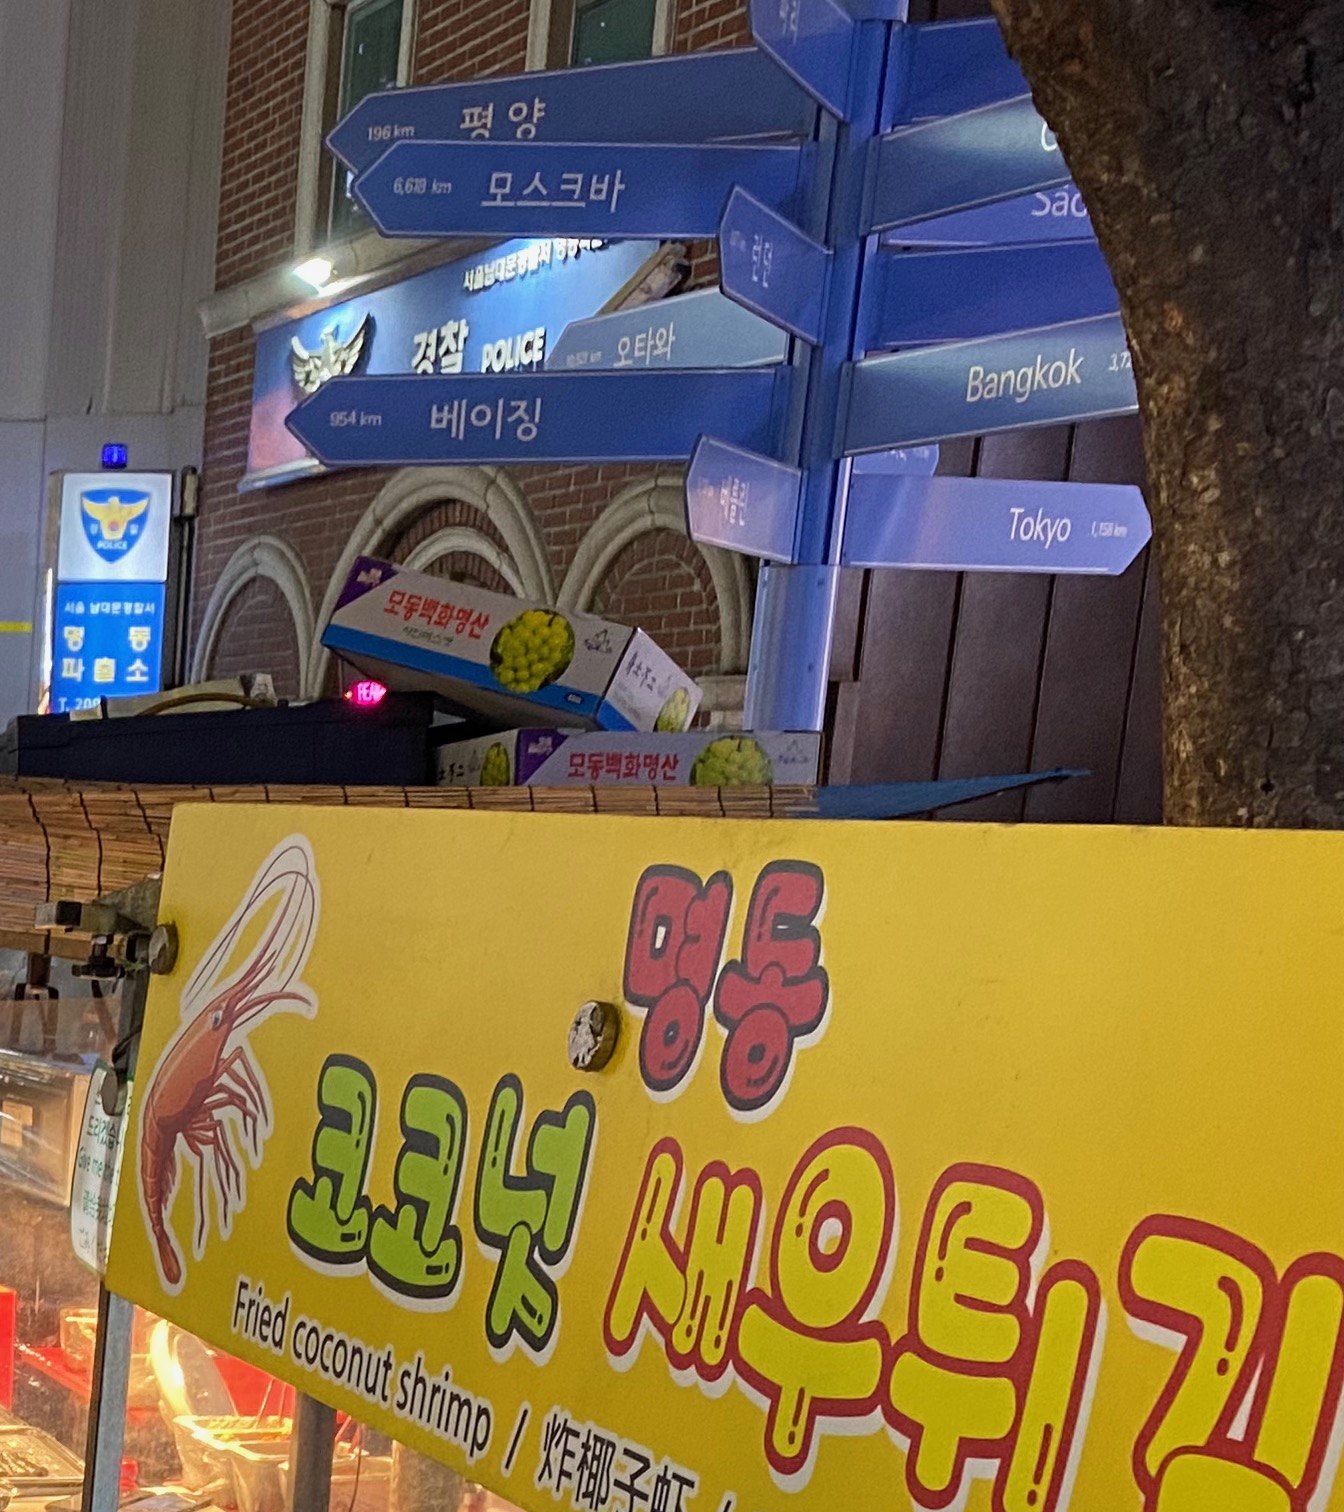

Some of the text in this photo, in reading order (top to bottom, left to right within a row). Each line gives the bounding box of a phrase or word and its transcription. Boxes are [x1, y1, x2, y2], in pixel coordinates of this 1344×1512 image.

[393, 124, 415, 138] km
[459, 97, 547, 139] 평양
[431, 180, 452, 194] km
[480, 169, 626, 214] 모스크바
[412, 319, 546, 375] 경찰 POLICE
[613, 322, 676, 367] 오타와
[965, 348, 1132, 403] Bangkok 3,72
[330, 398, 542, 443] 954 km 베이징
[97, 540, 128, 550] POLICE
[1010, 507, 1071, 549] Tokyo
[383, 589, 490, 640] 모동백화명산
[64, 625, 151, 652] 명동
[62, 657, 150, 682] 파출소
[568, 752, 679, 782] 모동백화명산
[623, 860, 830, 1112] 명동
[286, 1052, 596, 1354] 코코넛
[231, 1280, 288, 1351] Fried
[291, 1314, 395, 1404] coconut
[396, 1349, 492, 1457] shrimp
